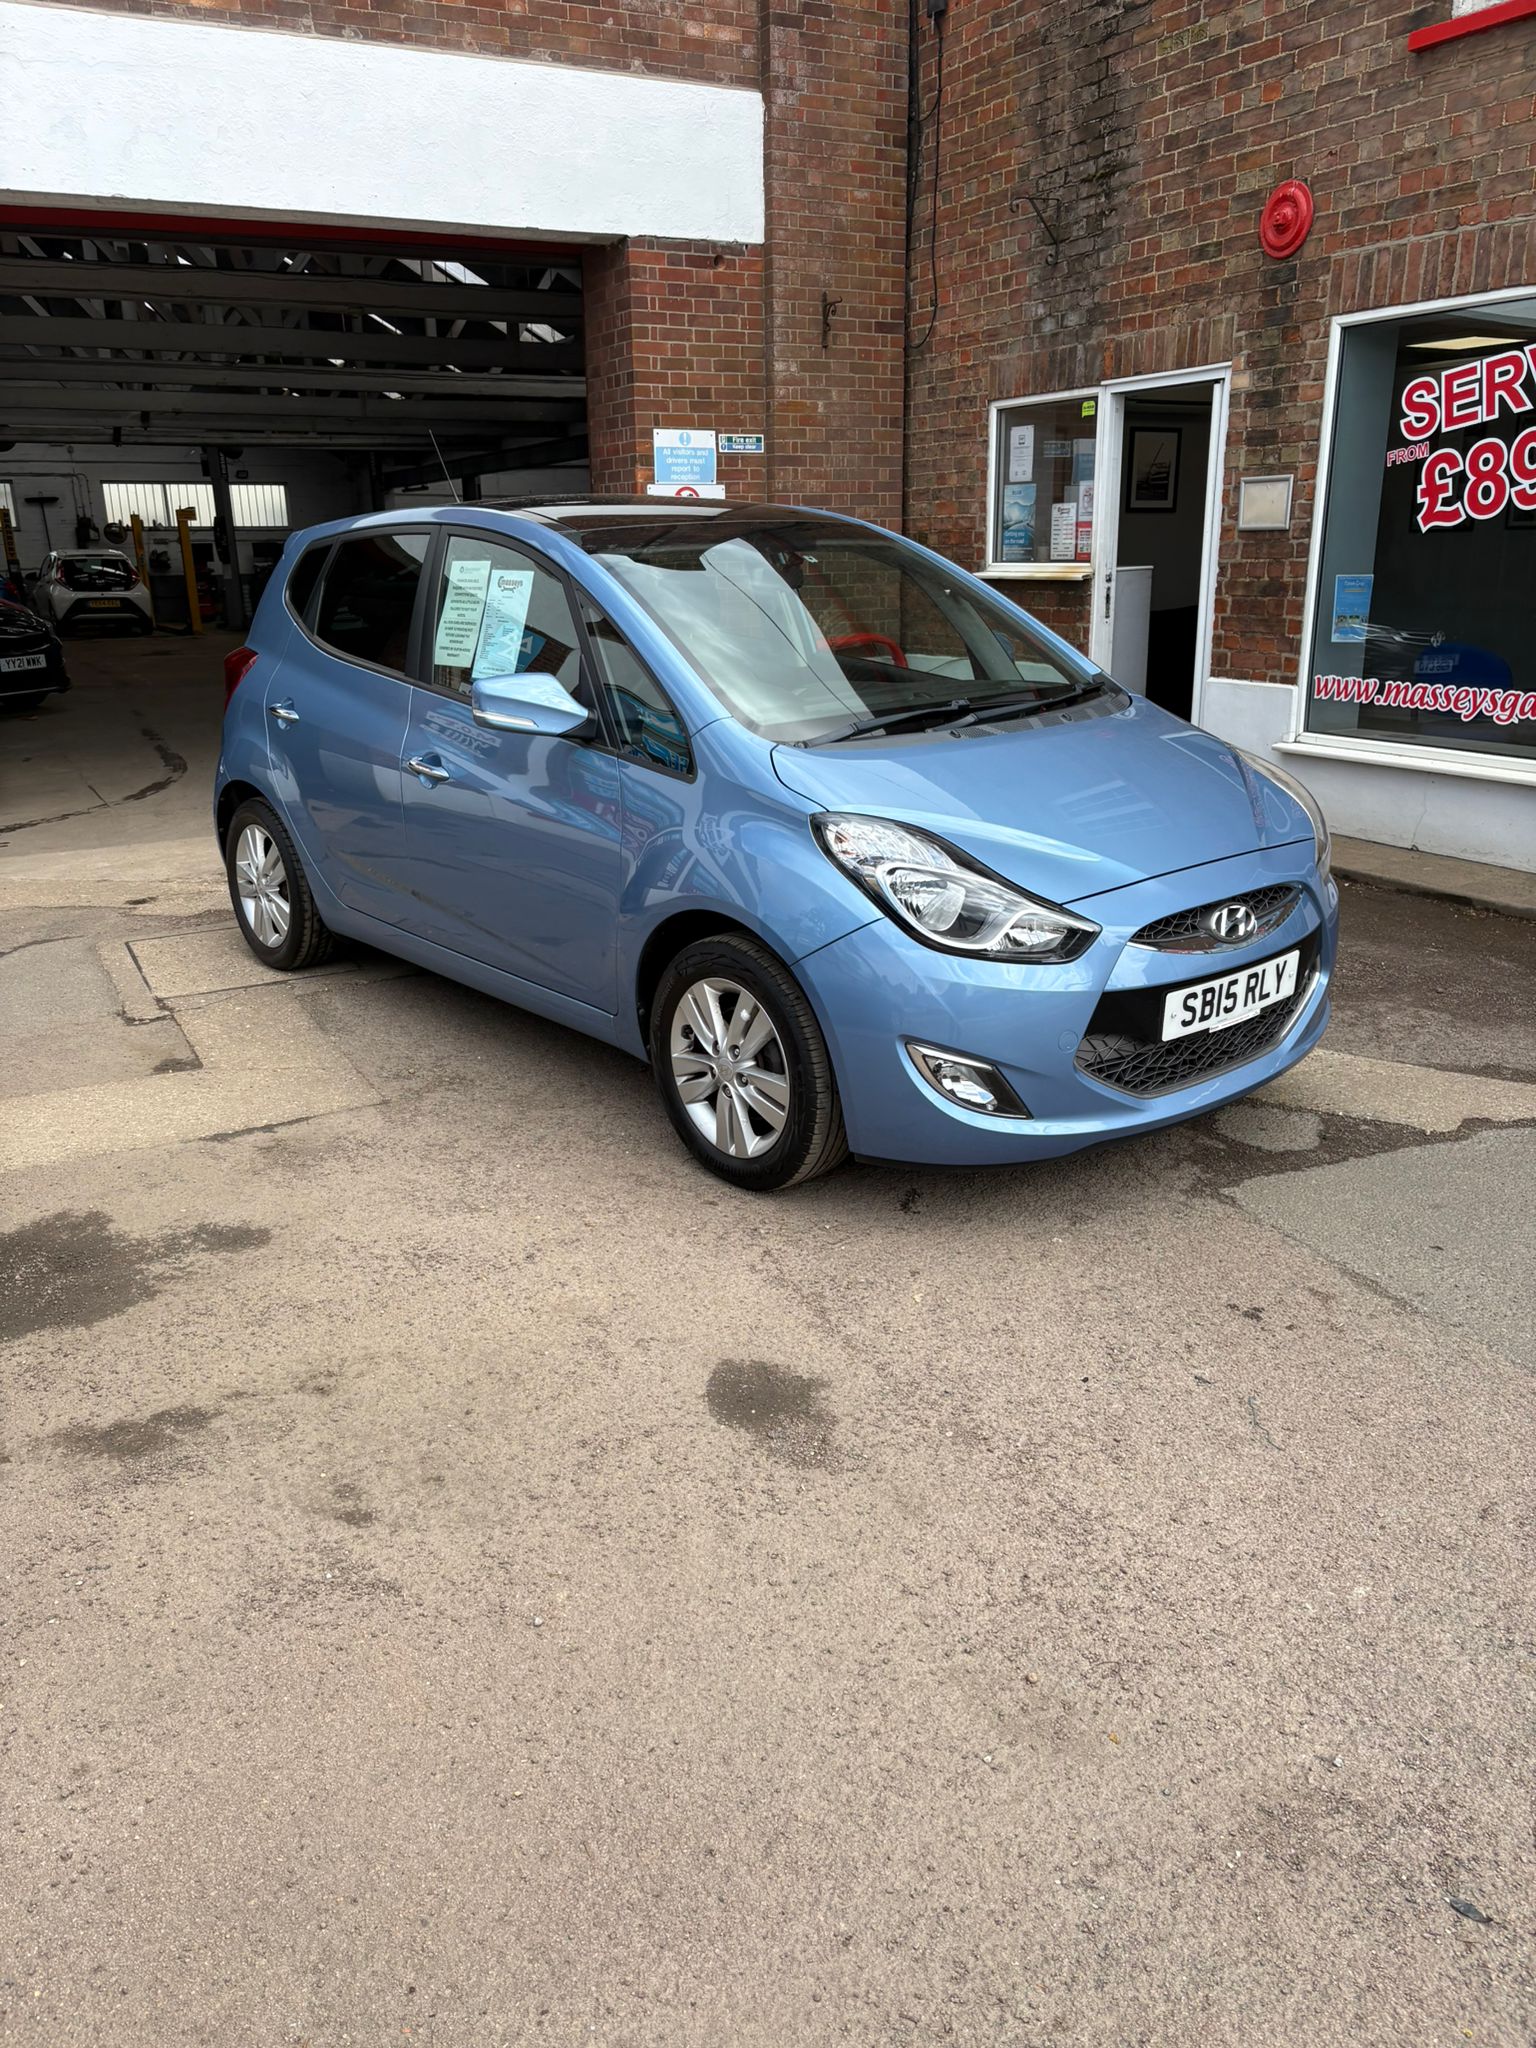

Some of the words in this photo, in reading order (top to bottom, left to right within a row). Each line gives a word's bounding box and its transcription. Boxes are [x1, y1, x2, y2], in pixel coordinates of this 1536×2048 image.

[732, 436, 744, 444] Fire
[745, 436, 757, 444] exit
[672, 448, 695, 456] visitors
[1386, 441, 1429, 468] FROM
[689, 457, 705, 465] must
[671, 465, 691, 474] report
[670, 473, 700, 481] reception
[1181, 979, 1239, 1027] SB15
[1243, 960, 1288, 1008] RLY
